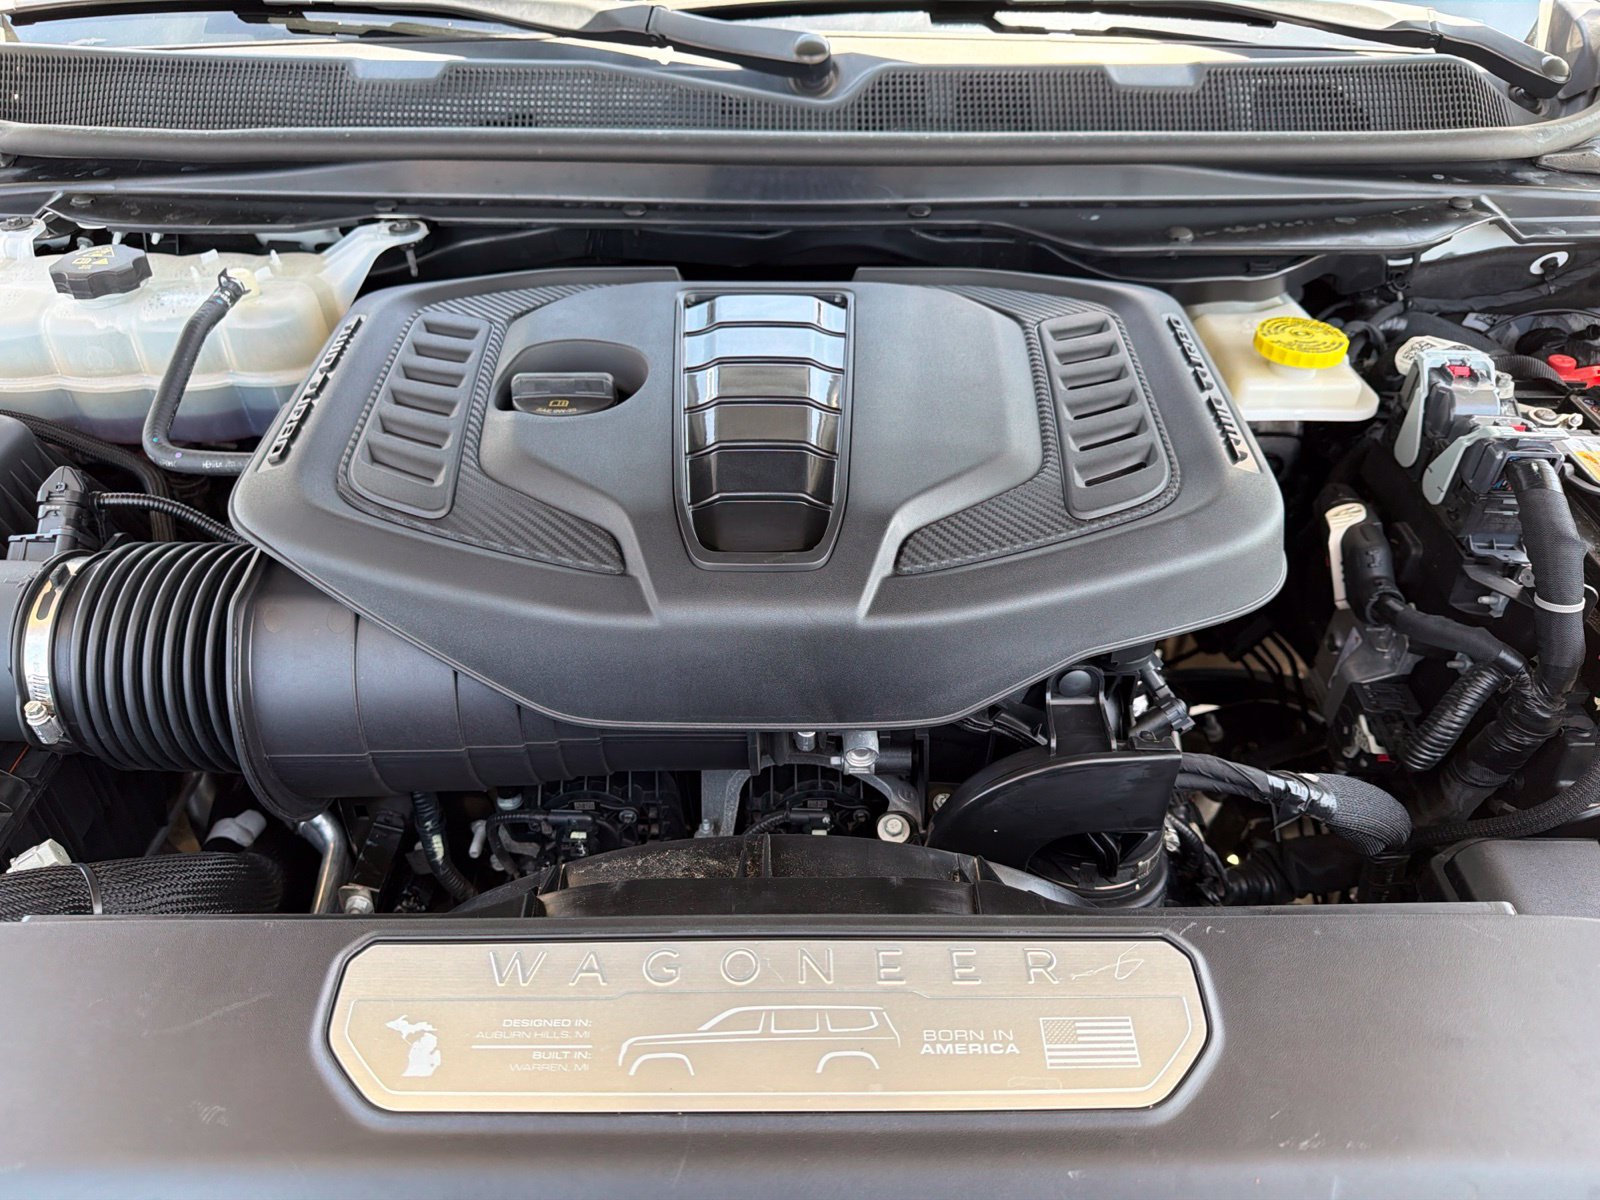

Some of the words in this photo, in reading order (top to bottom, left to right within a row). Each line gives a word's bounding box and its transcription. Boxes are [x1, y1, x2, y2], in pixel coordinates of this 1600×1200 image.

[1168, 317, 1214, 391] TURBO
[268, 372, 329, 463] TURBO
[489, 947, 1059, 986] WAGONEER
[503, 1019, 571, 1027] DESIGNED
[575, 1019, 593, 1027] IN:
[476, 1031, 532, 1039] AUBURN
[923, 1029, 985, 1041] BORN
[993, 1029, 1014, 1041] IN
[920, 1043, 1020, 1054] AMERICA
[532, 1051, 571, 1060] BUILT
[574, 1051, 593, 1060] IN:
[574, 1063, 590, 1071] MI
